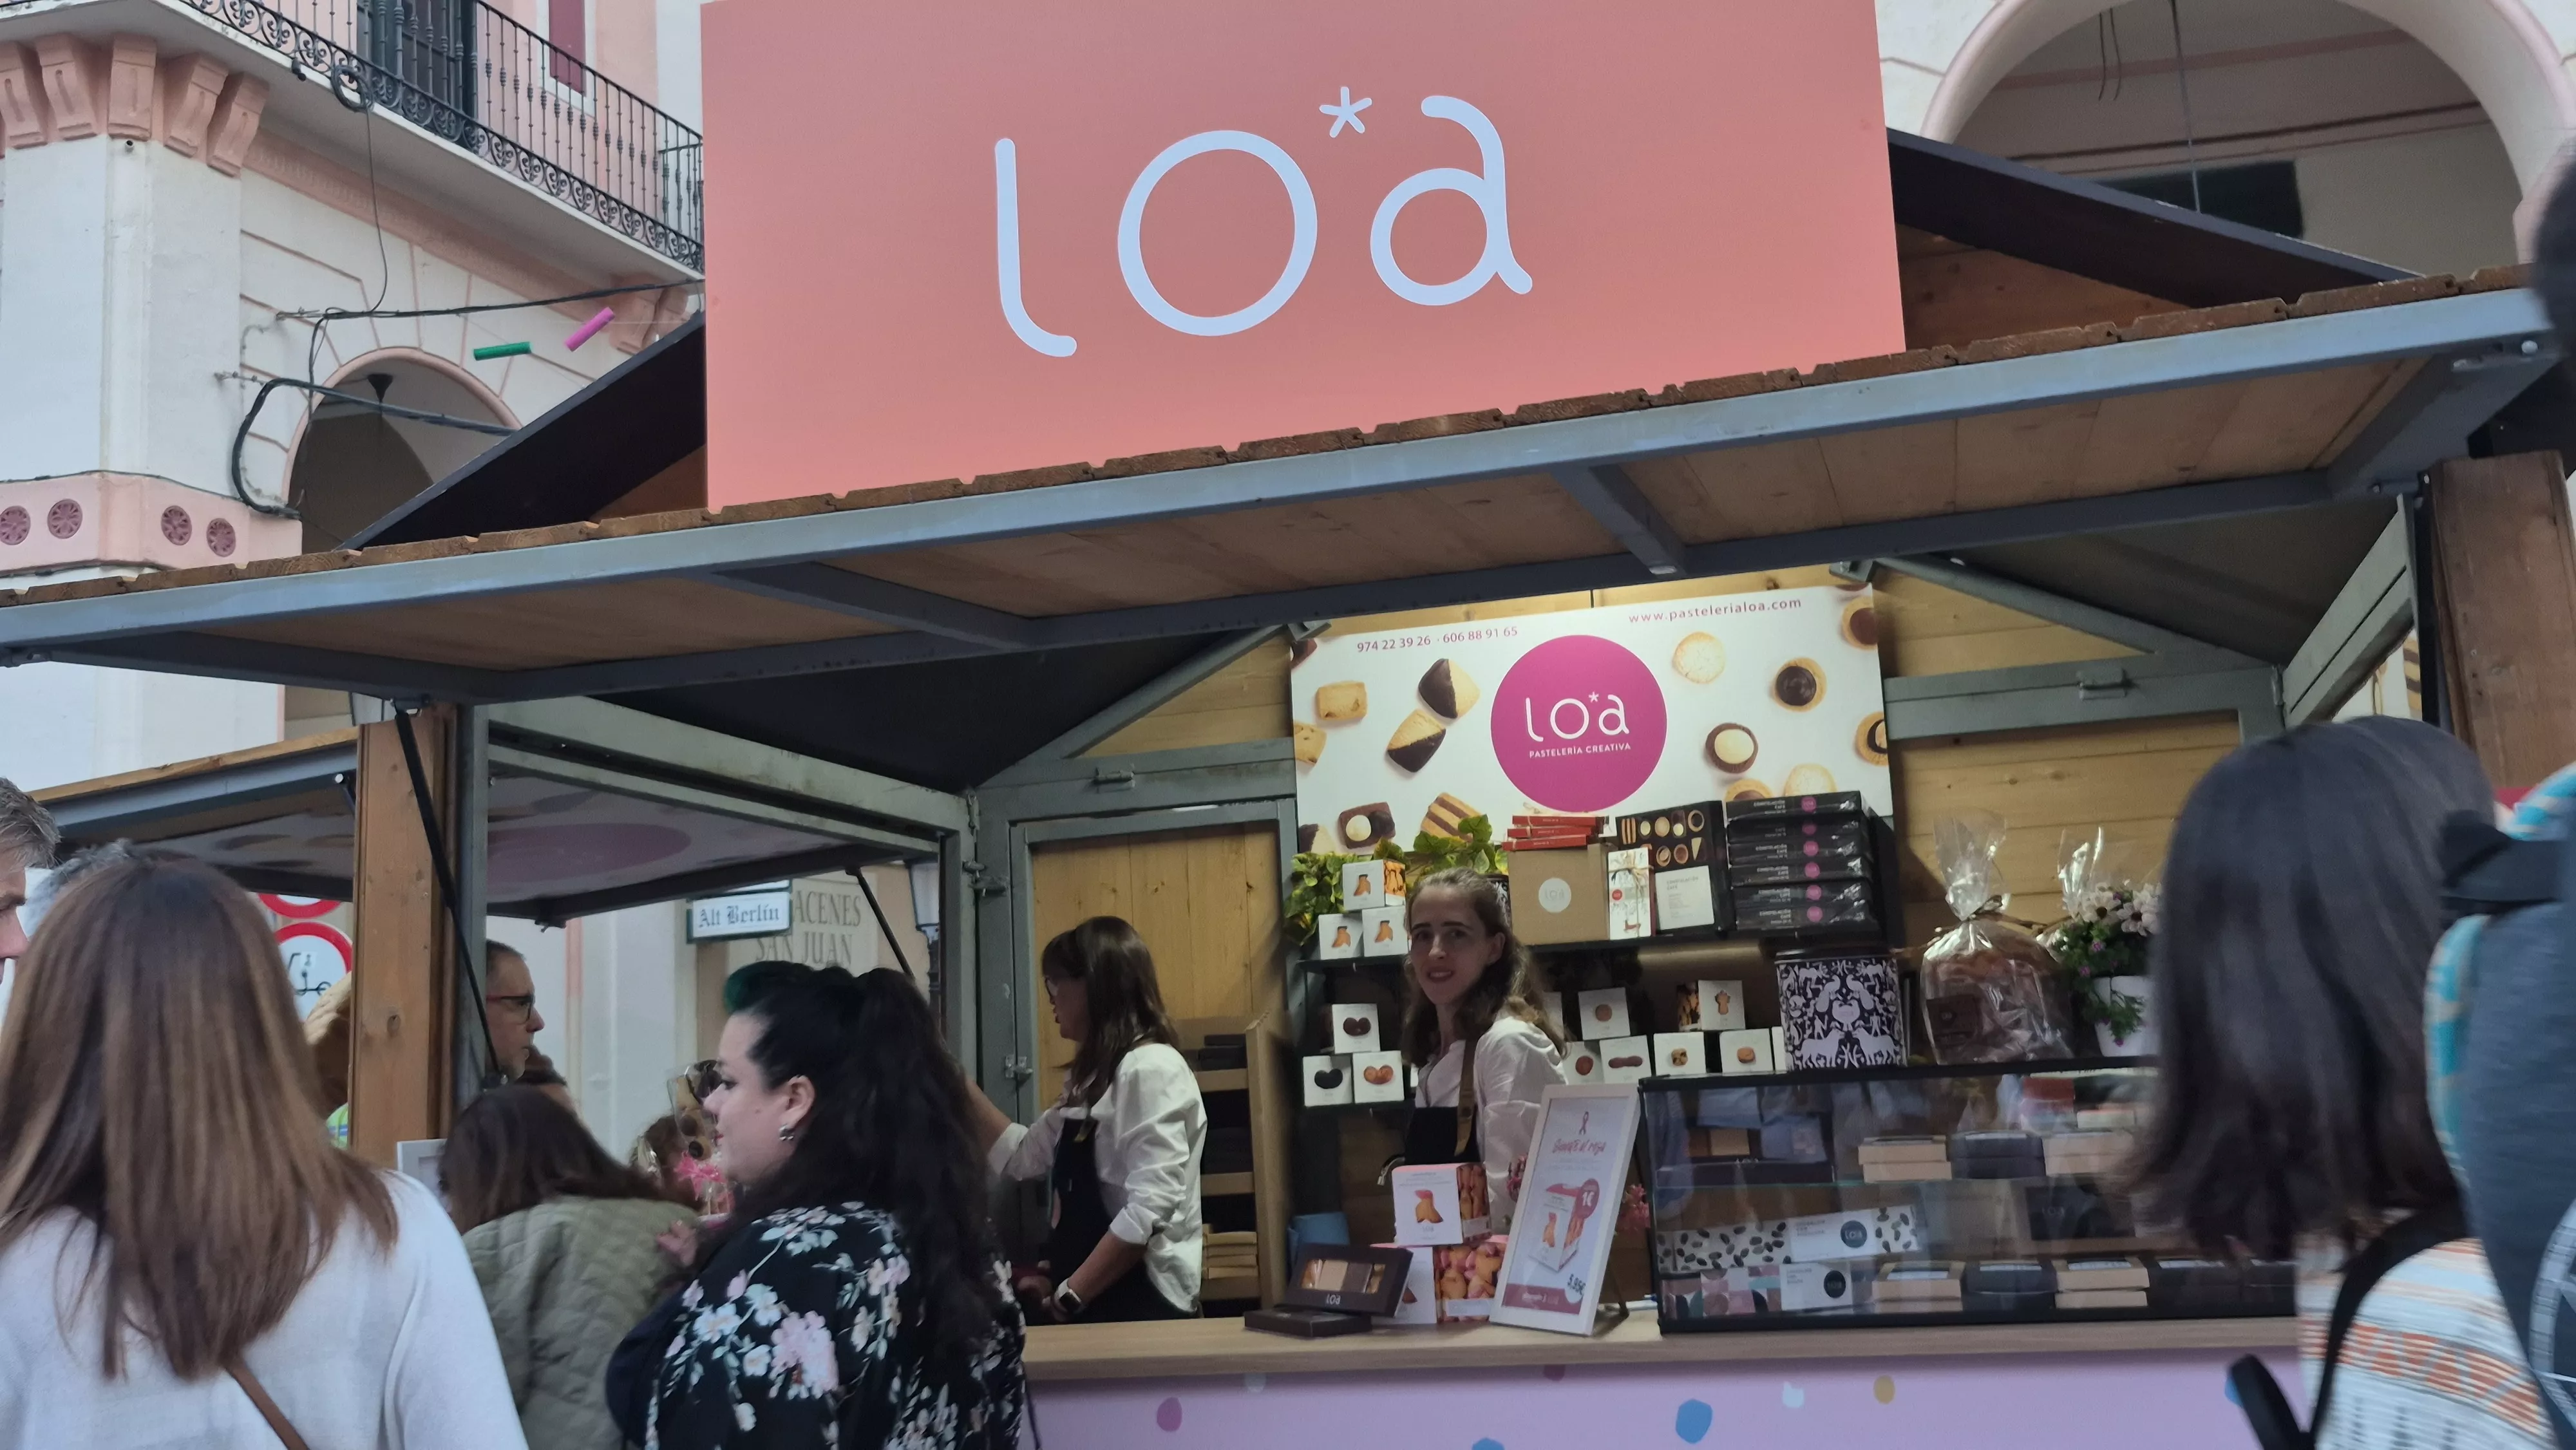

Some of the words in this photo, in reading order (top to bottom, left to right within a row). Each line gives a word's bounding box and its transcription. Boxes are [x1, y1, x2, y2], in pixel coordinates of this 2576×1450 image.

[1629, 598, 1801, 623] www.pastelerialoa.com
[1357, 641, 1378, 652] 974
[1382, 639, 1396, 650] 22
[1399, 637, 1414, 648] 39
[1417, 635, 1431, 646] 26
[1443, 632, 1464, 643] 606
[1468, 630, 1482, 641] 88
[1486, 628, 1499, 638] 91
[1504, 626, 1518, 636] 65
[1530, 746, 1582, 758] PASTELERÍA
[1586, 742, 1631, 753] CREATIVA
[699, 909, 721, 927] Alt
[793, 890, 861, 927] ACENES
[755, 935, 793, 962] SAN
[803, 931, 853, 965] JUAN
